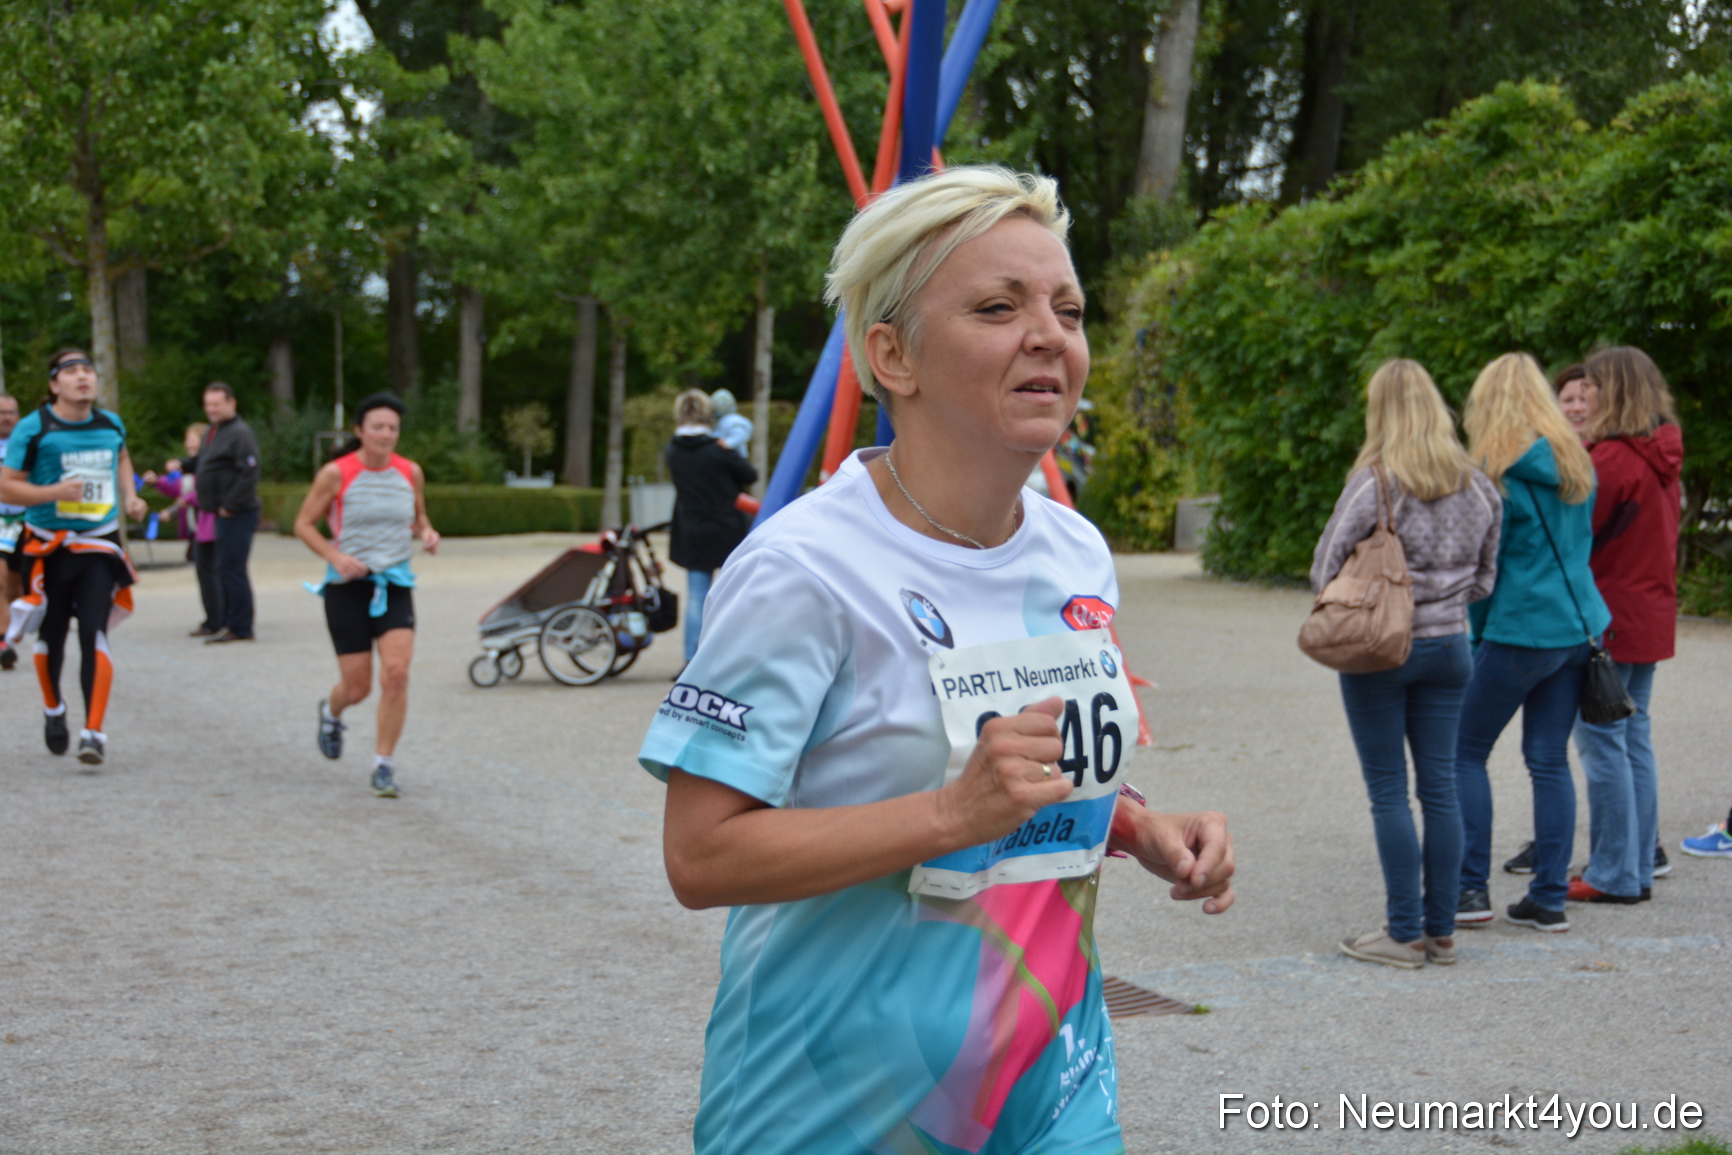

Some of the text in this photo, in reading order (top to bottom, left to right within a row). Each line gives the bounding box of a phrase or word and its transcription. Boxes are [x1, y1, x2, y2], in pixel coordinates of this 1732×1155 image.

[942, 670, 1011, 700] PARTL
[1014, 657, 1098, 689] Neumarkt
[663, 683, 754, 732] OCK
[671, 708, 684, 720] by
[685, 713, 711, 729] smart
[711, 723, 746, 742] concepts
